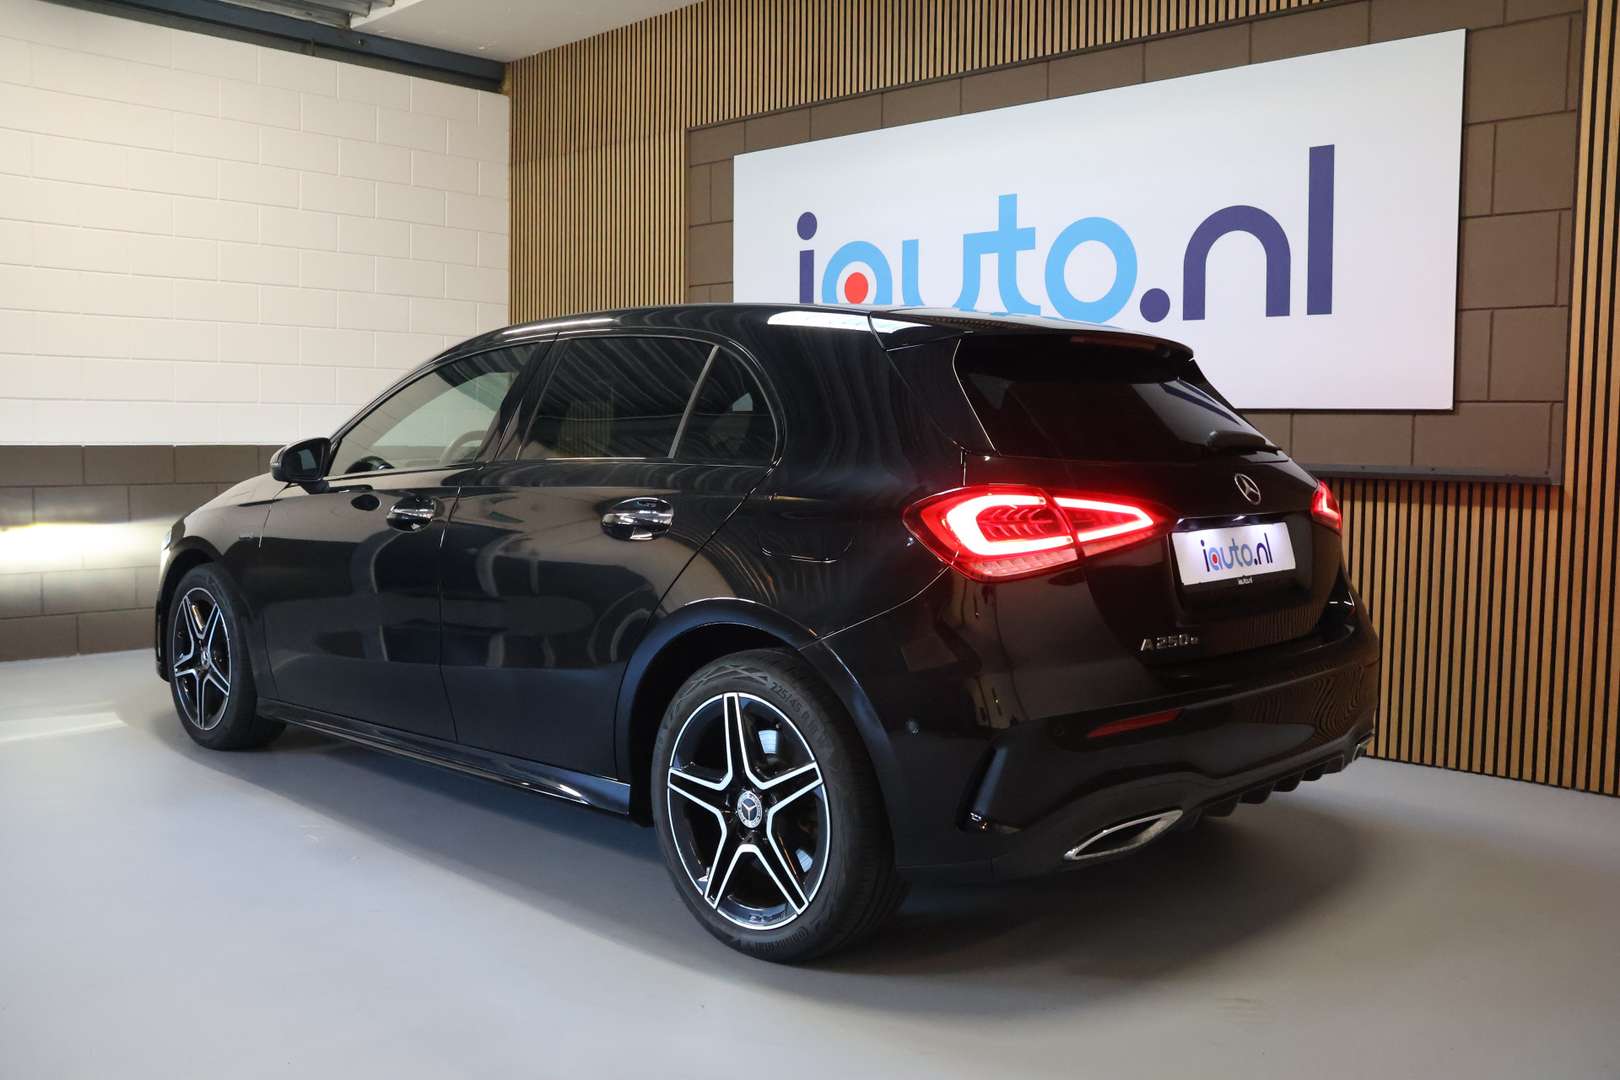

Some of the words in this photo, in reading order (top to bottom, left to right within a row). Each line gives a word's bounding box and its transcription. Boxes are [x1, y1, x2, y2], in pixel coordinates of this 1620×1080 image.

[797, 144, 1335, 324] iauto.nl
[1200, 532, 1273, 573] iauto.nl
[1140, 637, 1154, 651] A
